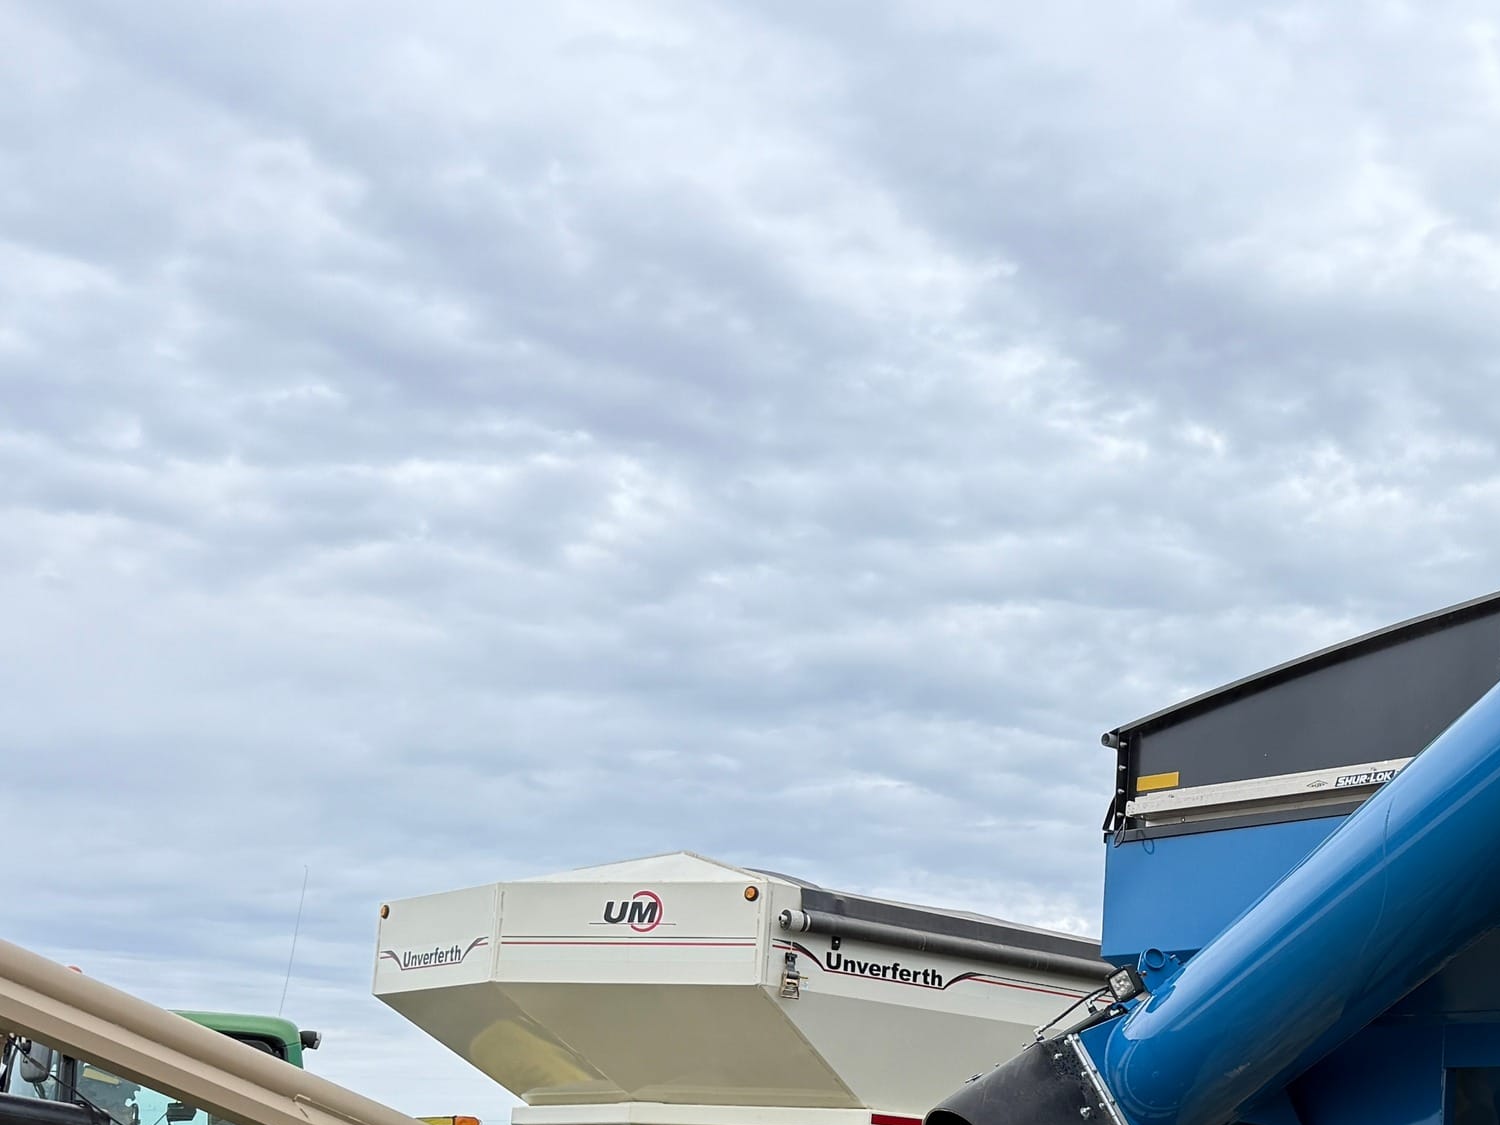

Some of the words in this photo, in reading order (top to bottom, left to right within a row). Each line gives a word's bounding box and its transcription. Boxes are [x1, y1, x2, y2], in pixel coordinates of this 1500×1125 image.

[603, 901, 658, 924] UM
[403, 945, 461, 967] Unverferth
[826, 951, 943, 986] Unverferth
